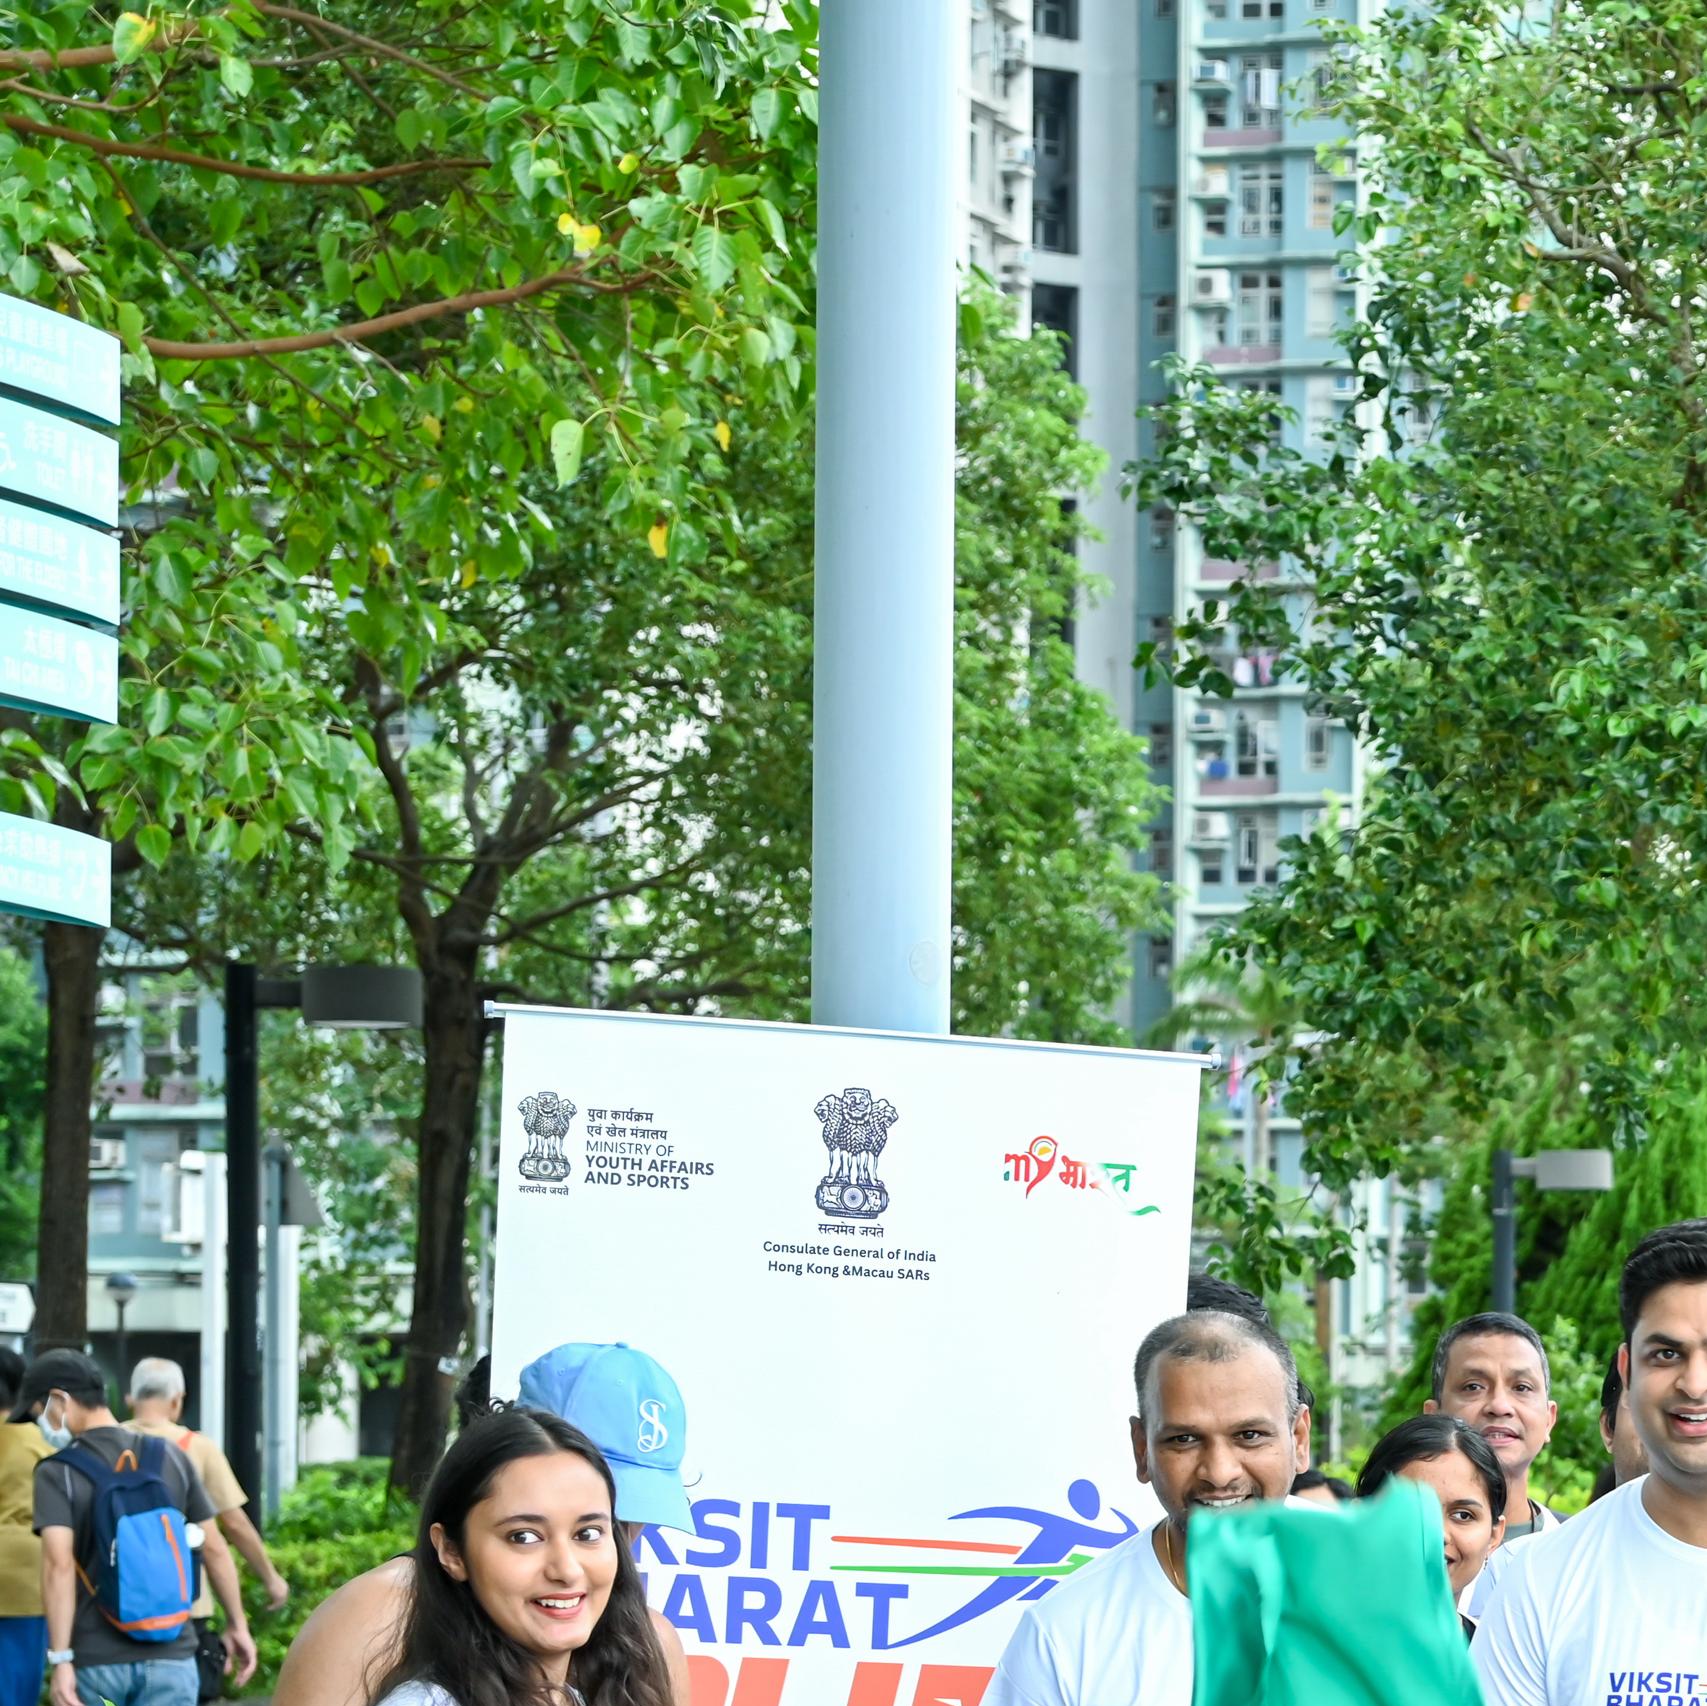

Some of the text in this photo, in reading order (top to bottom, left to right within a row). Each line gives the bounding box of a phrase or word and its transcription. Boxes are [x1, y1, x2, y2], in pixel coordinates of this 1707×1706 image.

[586, 1140, 675, 1157] MINISTRY OF
[585, 1155, 715, 1176] YOUTH AFFAIRS
[584, 1171, 690, 1190] AND SPORTS
[763, 1241, 937, 1263] Consulate General of India
[768, 1260, 930, 1281] Hong Kong &Macau SARs
[631, 1499, 830, 1571] KSIT
[637, 1572, 909, 1650] ARAT
[1609, 1671, 1700, 1695] VIKSIT
